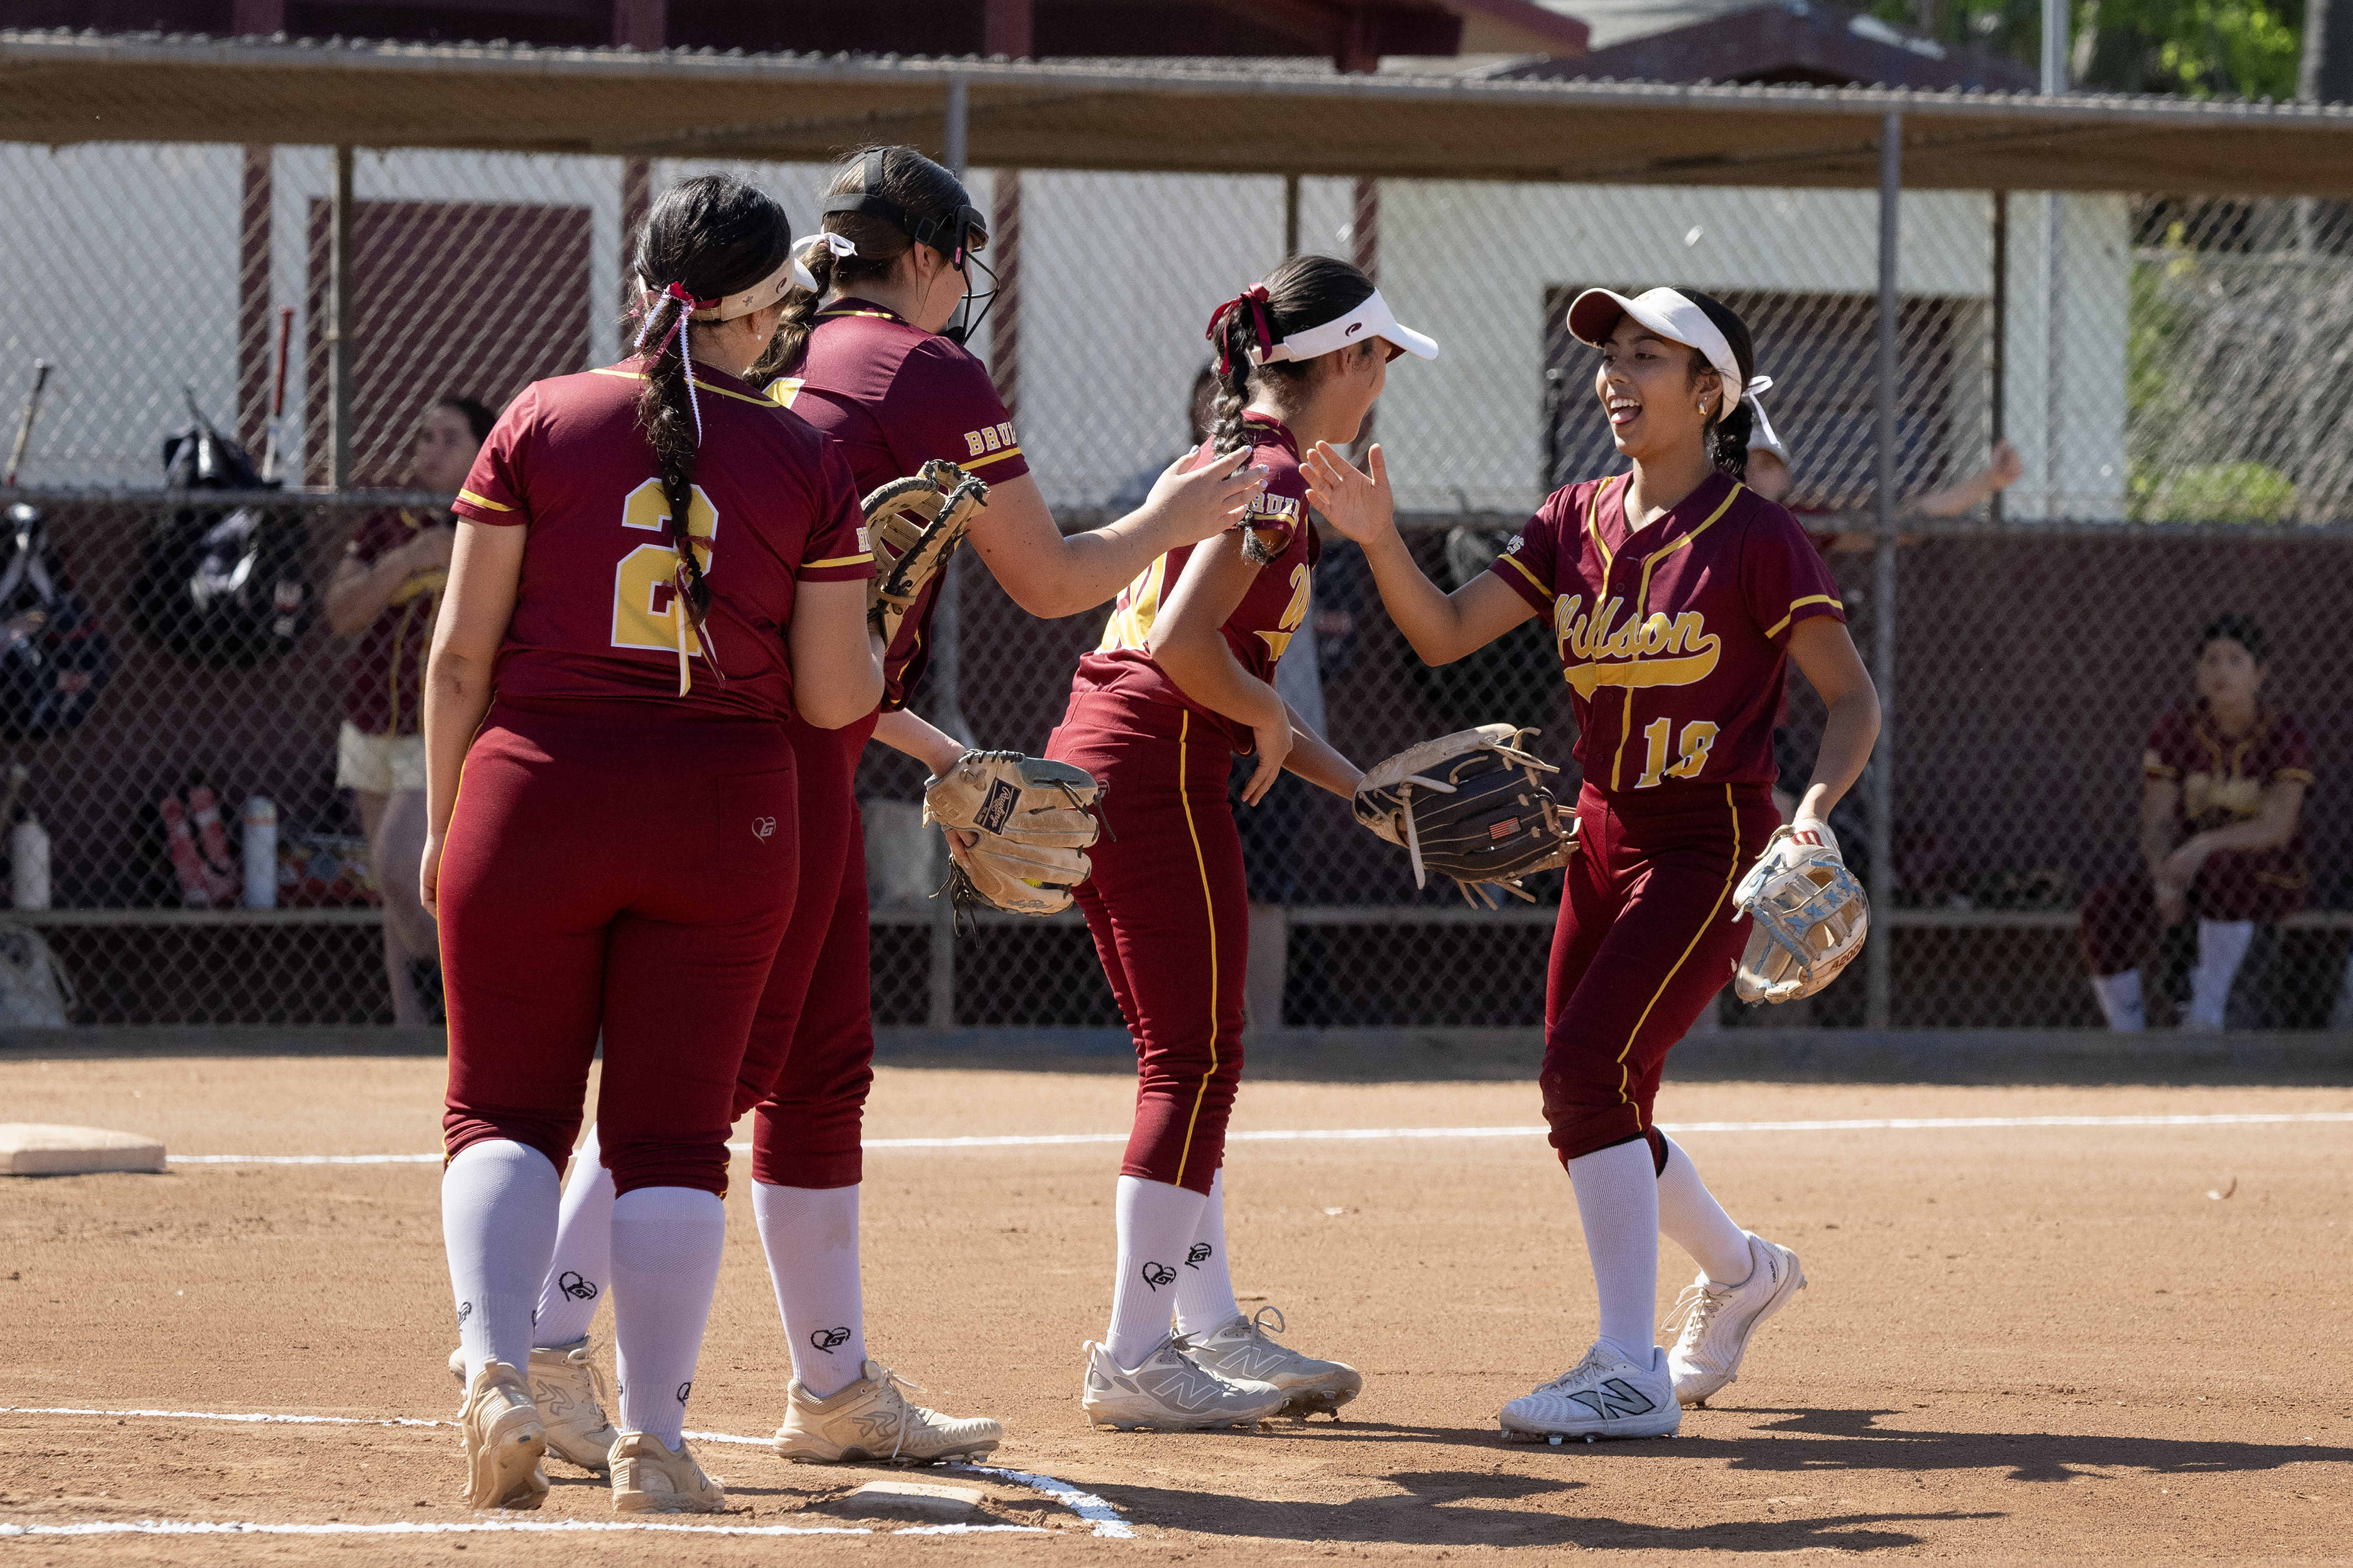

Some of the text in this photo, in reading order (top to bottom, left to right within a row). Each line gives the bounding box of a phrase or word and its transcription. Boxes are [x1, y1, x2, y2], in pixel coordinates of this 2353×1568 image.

[611, 477, 719, 657] 2
[1554, 594, 1721, 660] Wilson
[990, 786, 1011, 828] Rawlings
